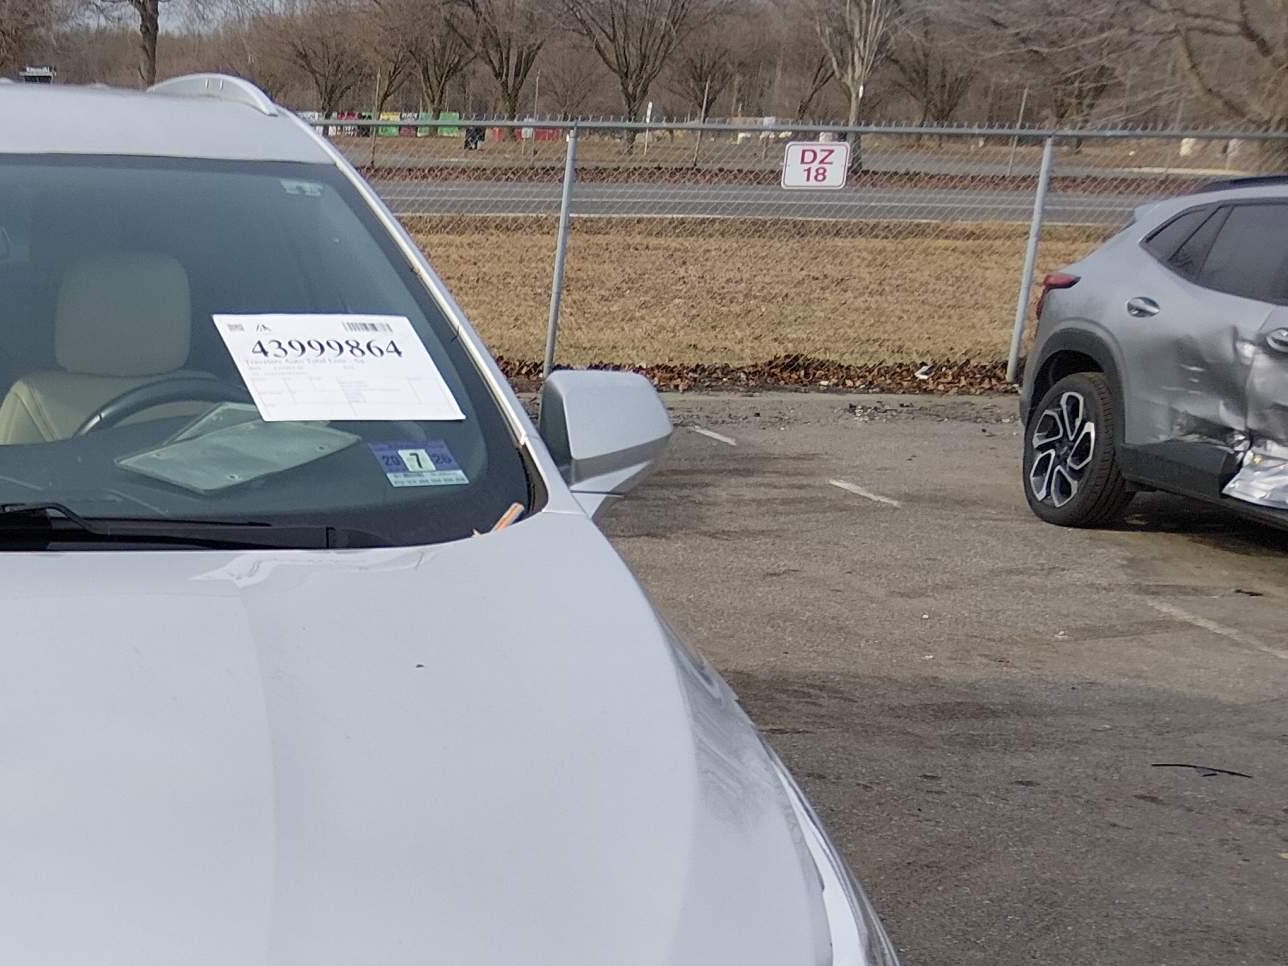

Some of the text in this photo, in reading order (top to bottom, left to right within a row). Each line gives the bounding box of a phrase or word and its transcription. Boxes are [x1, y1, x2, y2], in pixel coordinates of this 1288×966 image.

[799, 148, 835, 165] DZ
[802, 166, 828, 182] 18
[250, 339, 404, 358] 43999864
[382, 455, 402, 466] 20
[409, 452, 423, 469] 7
